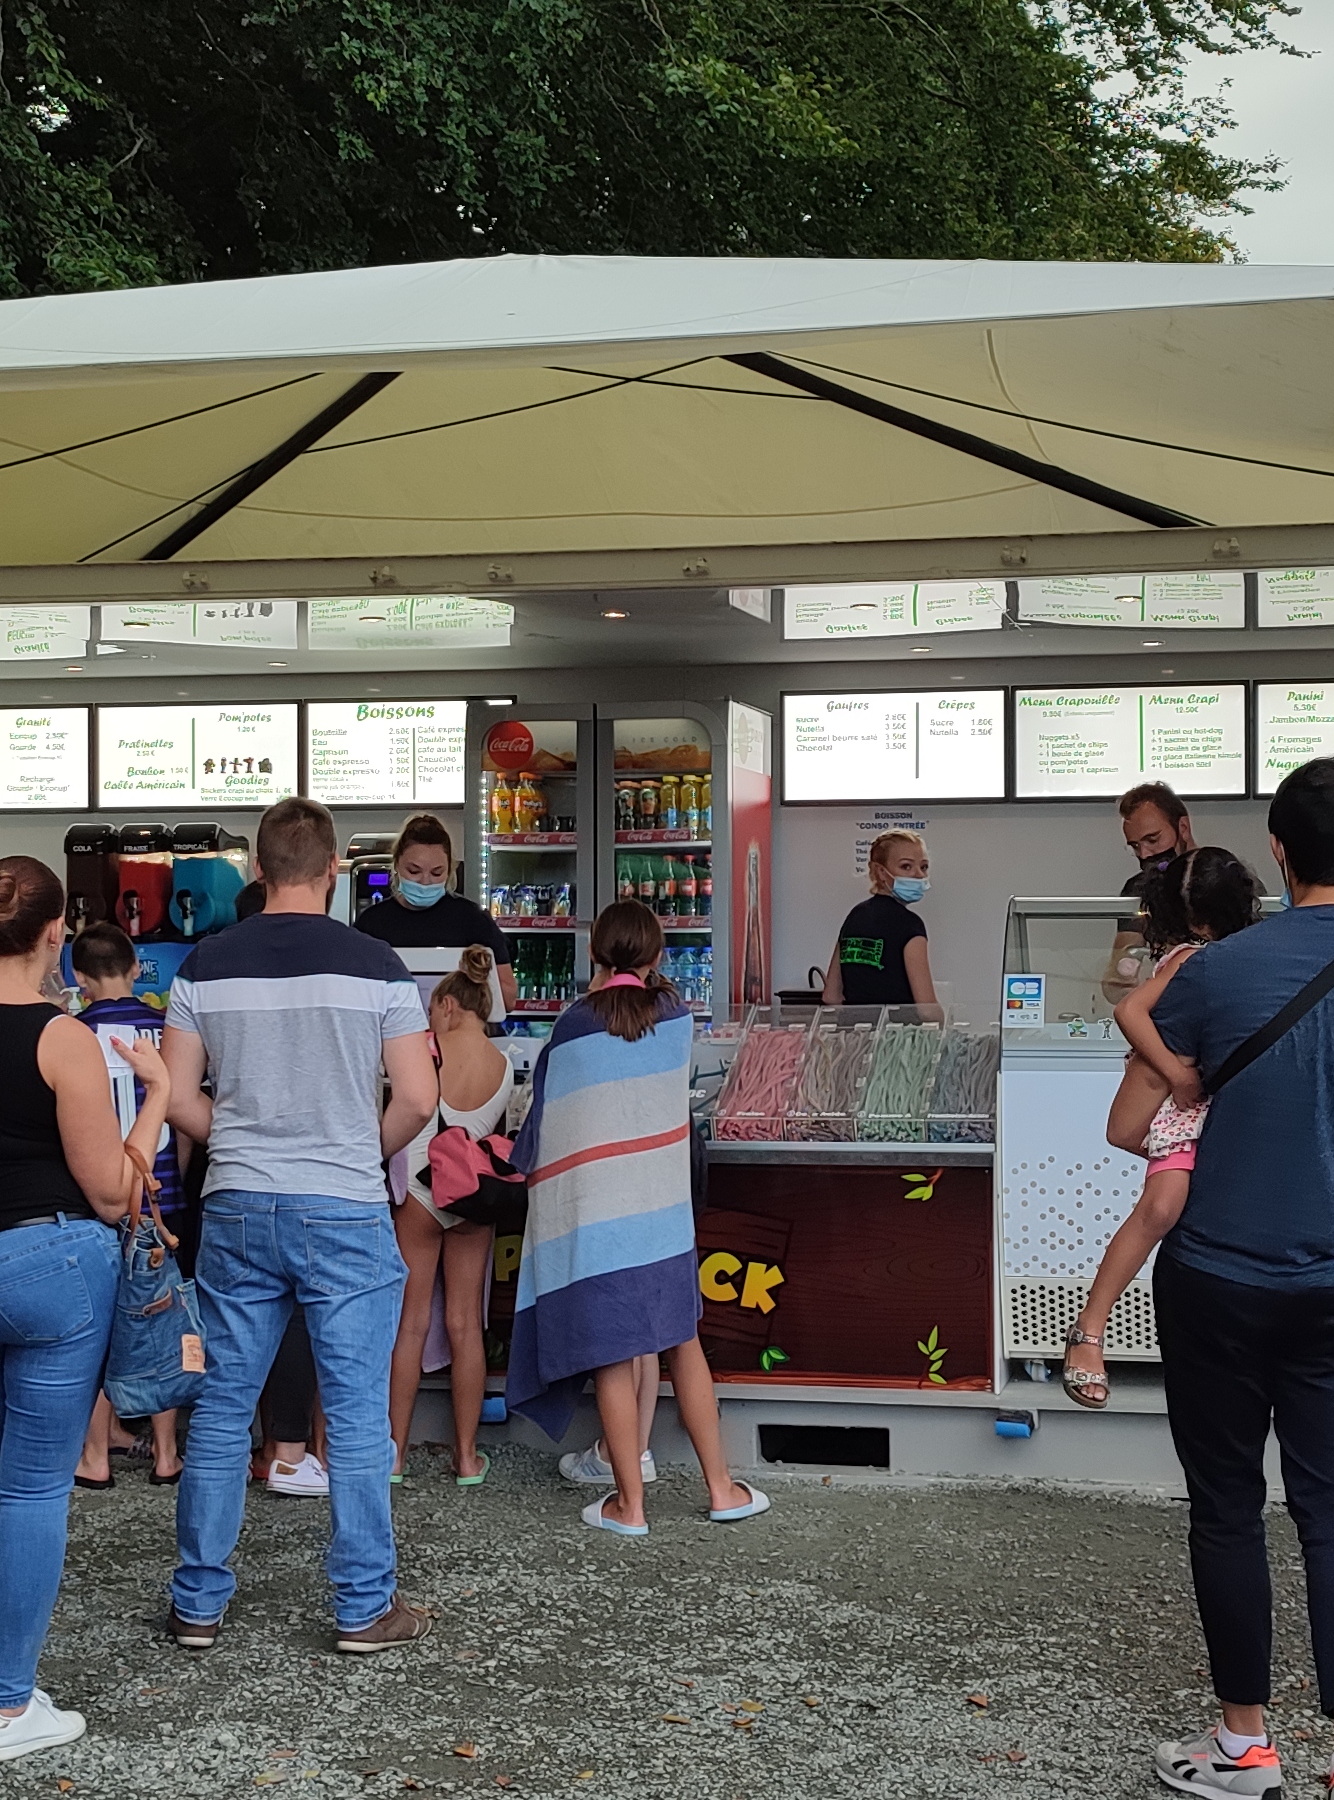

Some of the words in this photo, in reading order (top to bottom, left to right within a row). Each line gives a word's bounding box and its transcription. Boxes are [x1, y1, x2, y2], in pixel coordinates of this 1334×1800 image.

[1149, 694, 1183, 705] Menu
[1287, 691, 1324, 701] Panini
[1019, 697, 1053, 706] Menu
[218, 712, 271, 722] Pom'potes
[357, 704, 435, 721] Boissons
[225, 776, 269, 786] Goodies
[1010, 982, 1039, 995] CB
